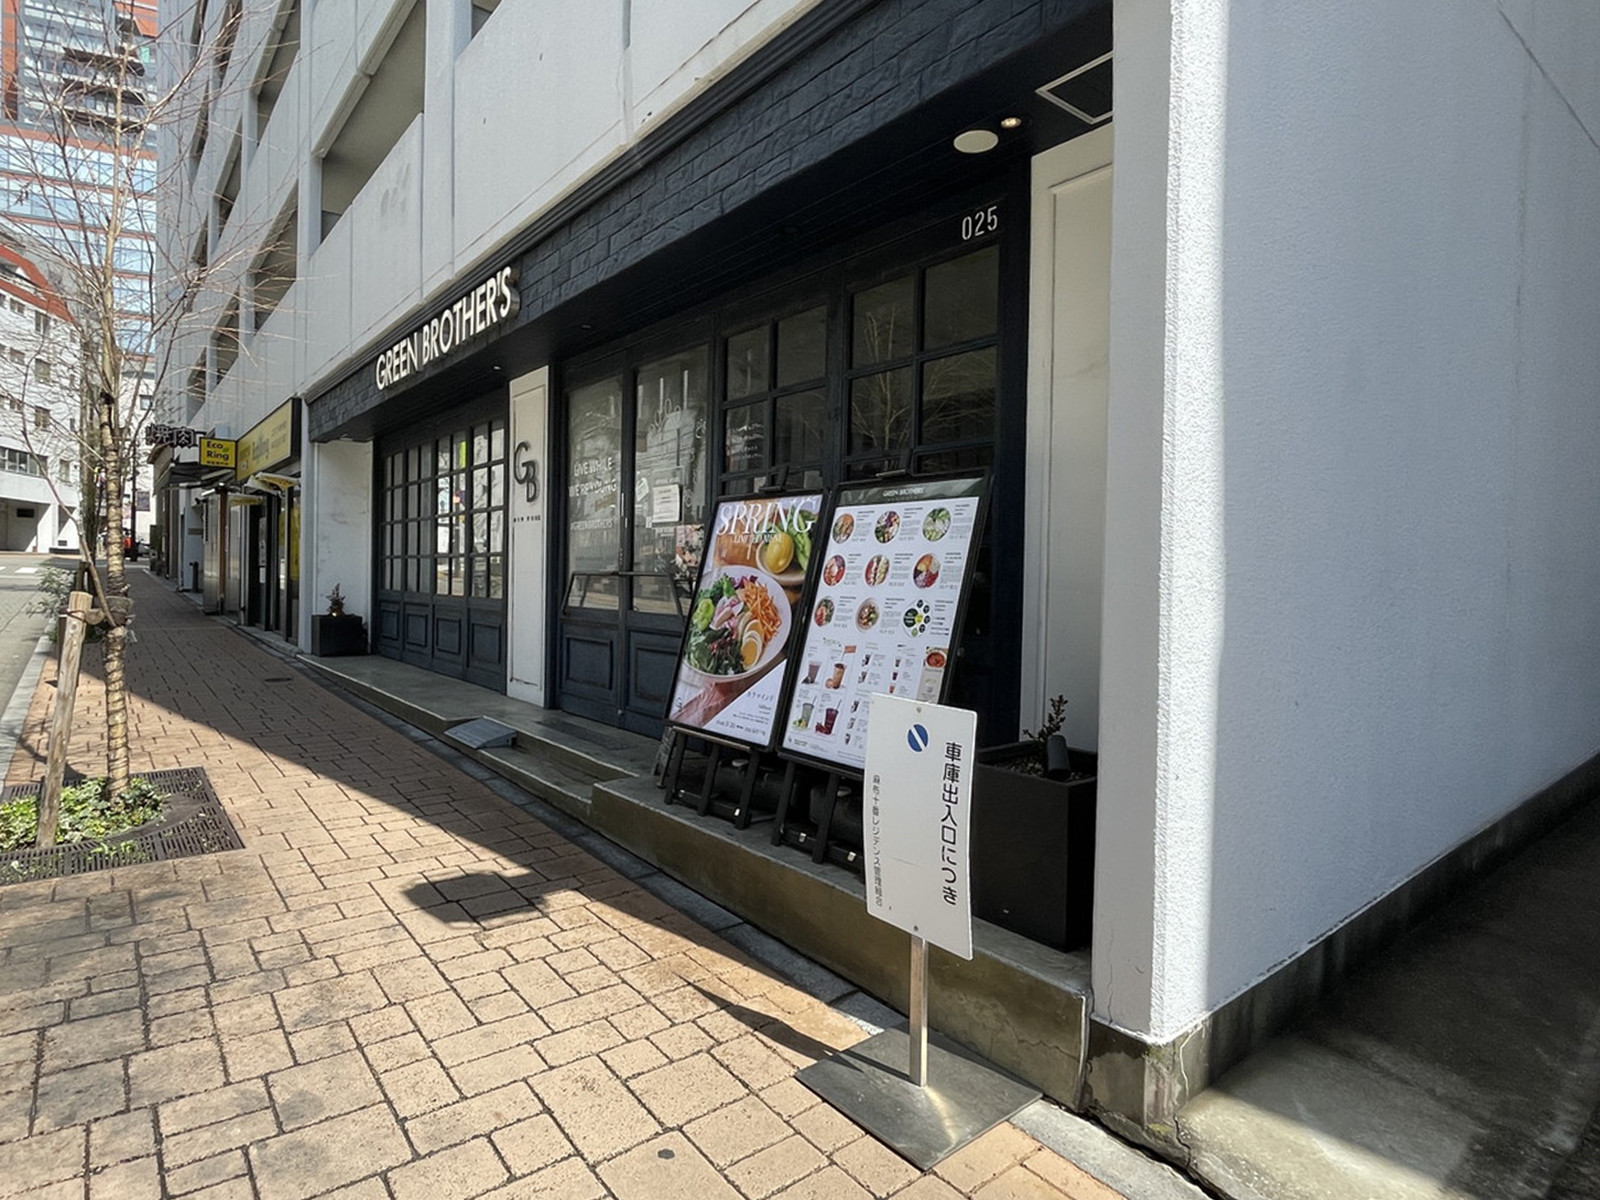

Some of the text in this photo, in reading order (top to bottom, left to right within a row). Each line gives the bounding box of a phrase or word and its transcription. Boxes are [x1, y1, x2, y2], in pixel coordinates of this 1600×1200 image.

[961, 206, 998, 240] 025
[376, 266, 512, 390] GREEN BROTHER'S
[206, 440, 224, 450] Eco
[206, 450, 230, 461] Ring
[716, 498, 818, 535] SPRING
[940, 741, 963, 906] 車庫出入口につき
